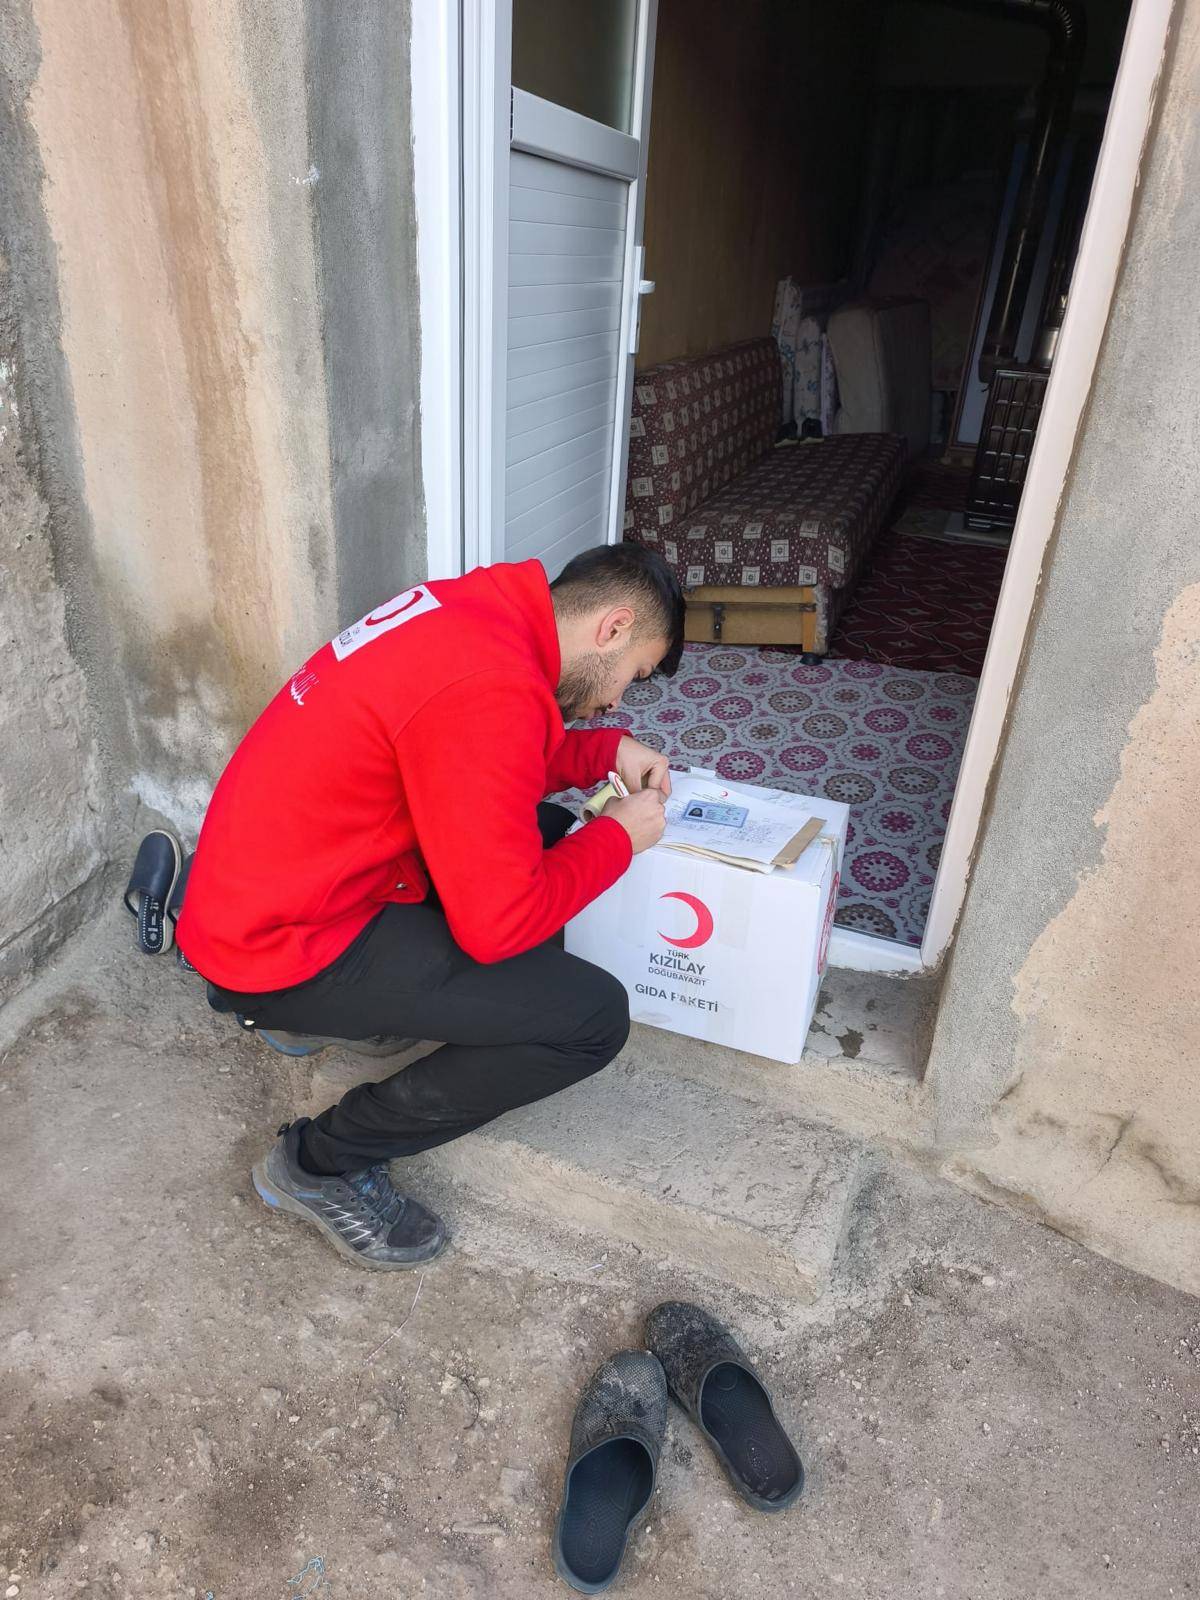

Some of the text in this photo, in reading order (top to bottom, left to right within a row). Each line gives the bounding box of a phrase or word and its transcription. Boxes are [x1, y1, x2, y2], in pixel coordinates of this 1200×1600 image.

[649, 952, 706, 975] KIZILAY
[648, 966, 706, 986] DOĞUBAYAZIT
[635, 983, 667, 1000] GIDA
